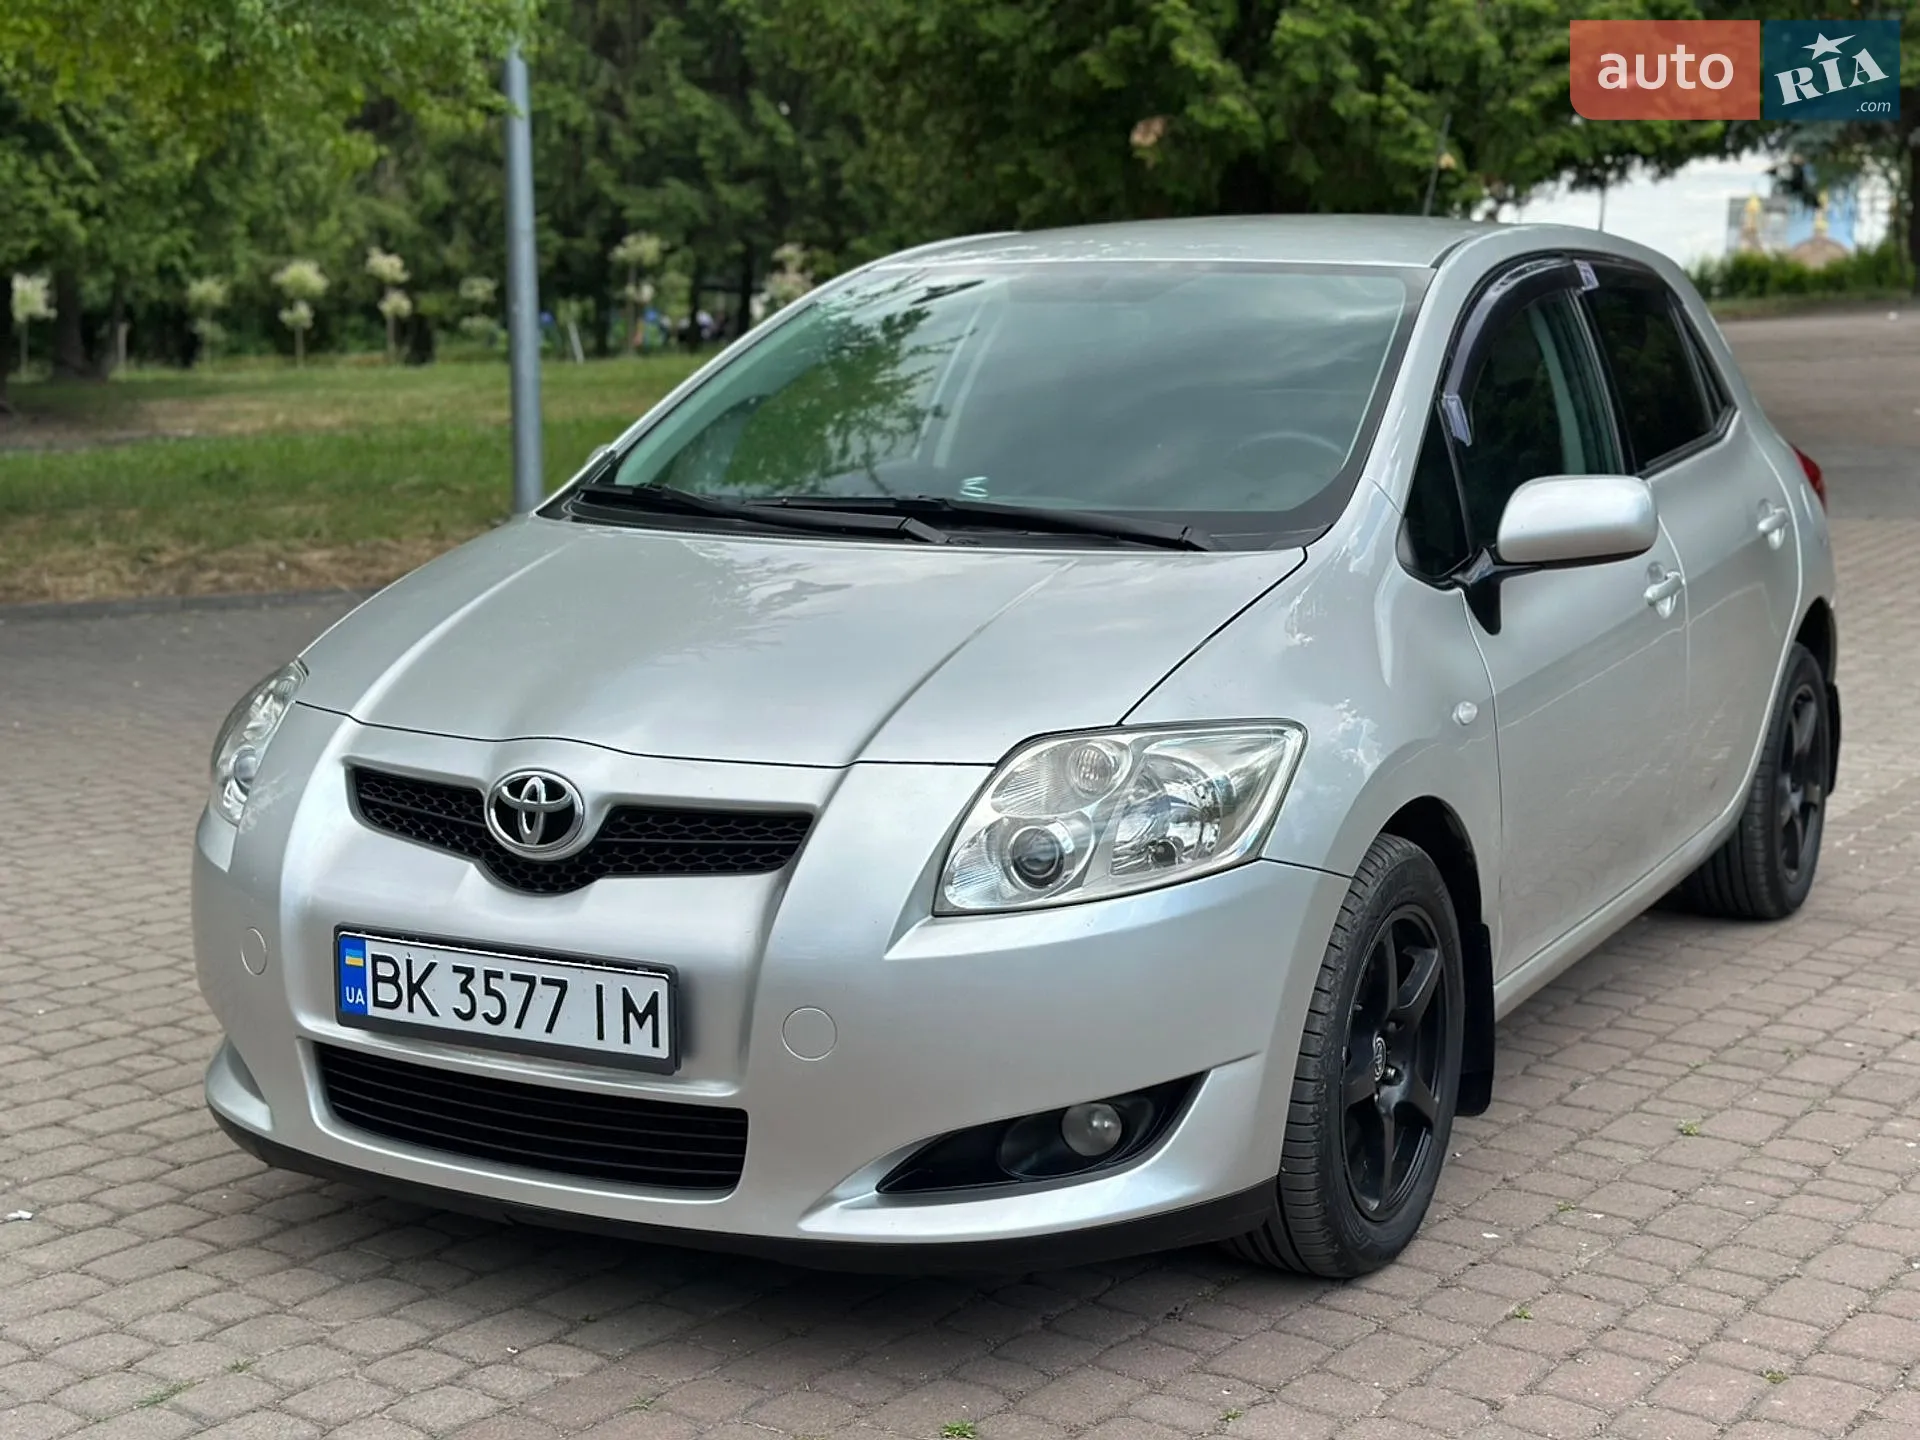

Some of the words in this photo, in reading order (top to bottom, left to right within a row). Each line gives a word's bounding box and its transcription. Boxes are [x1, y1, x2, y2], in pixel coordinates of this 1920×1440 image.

[346, 986, 365, 1005] UA
[371, 953, 440, 1018] BK
[452, 964, 569, 1034] 3577
[595, 983, 660, 1049] IM
